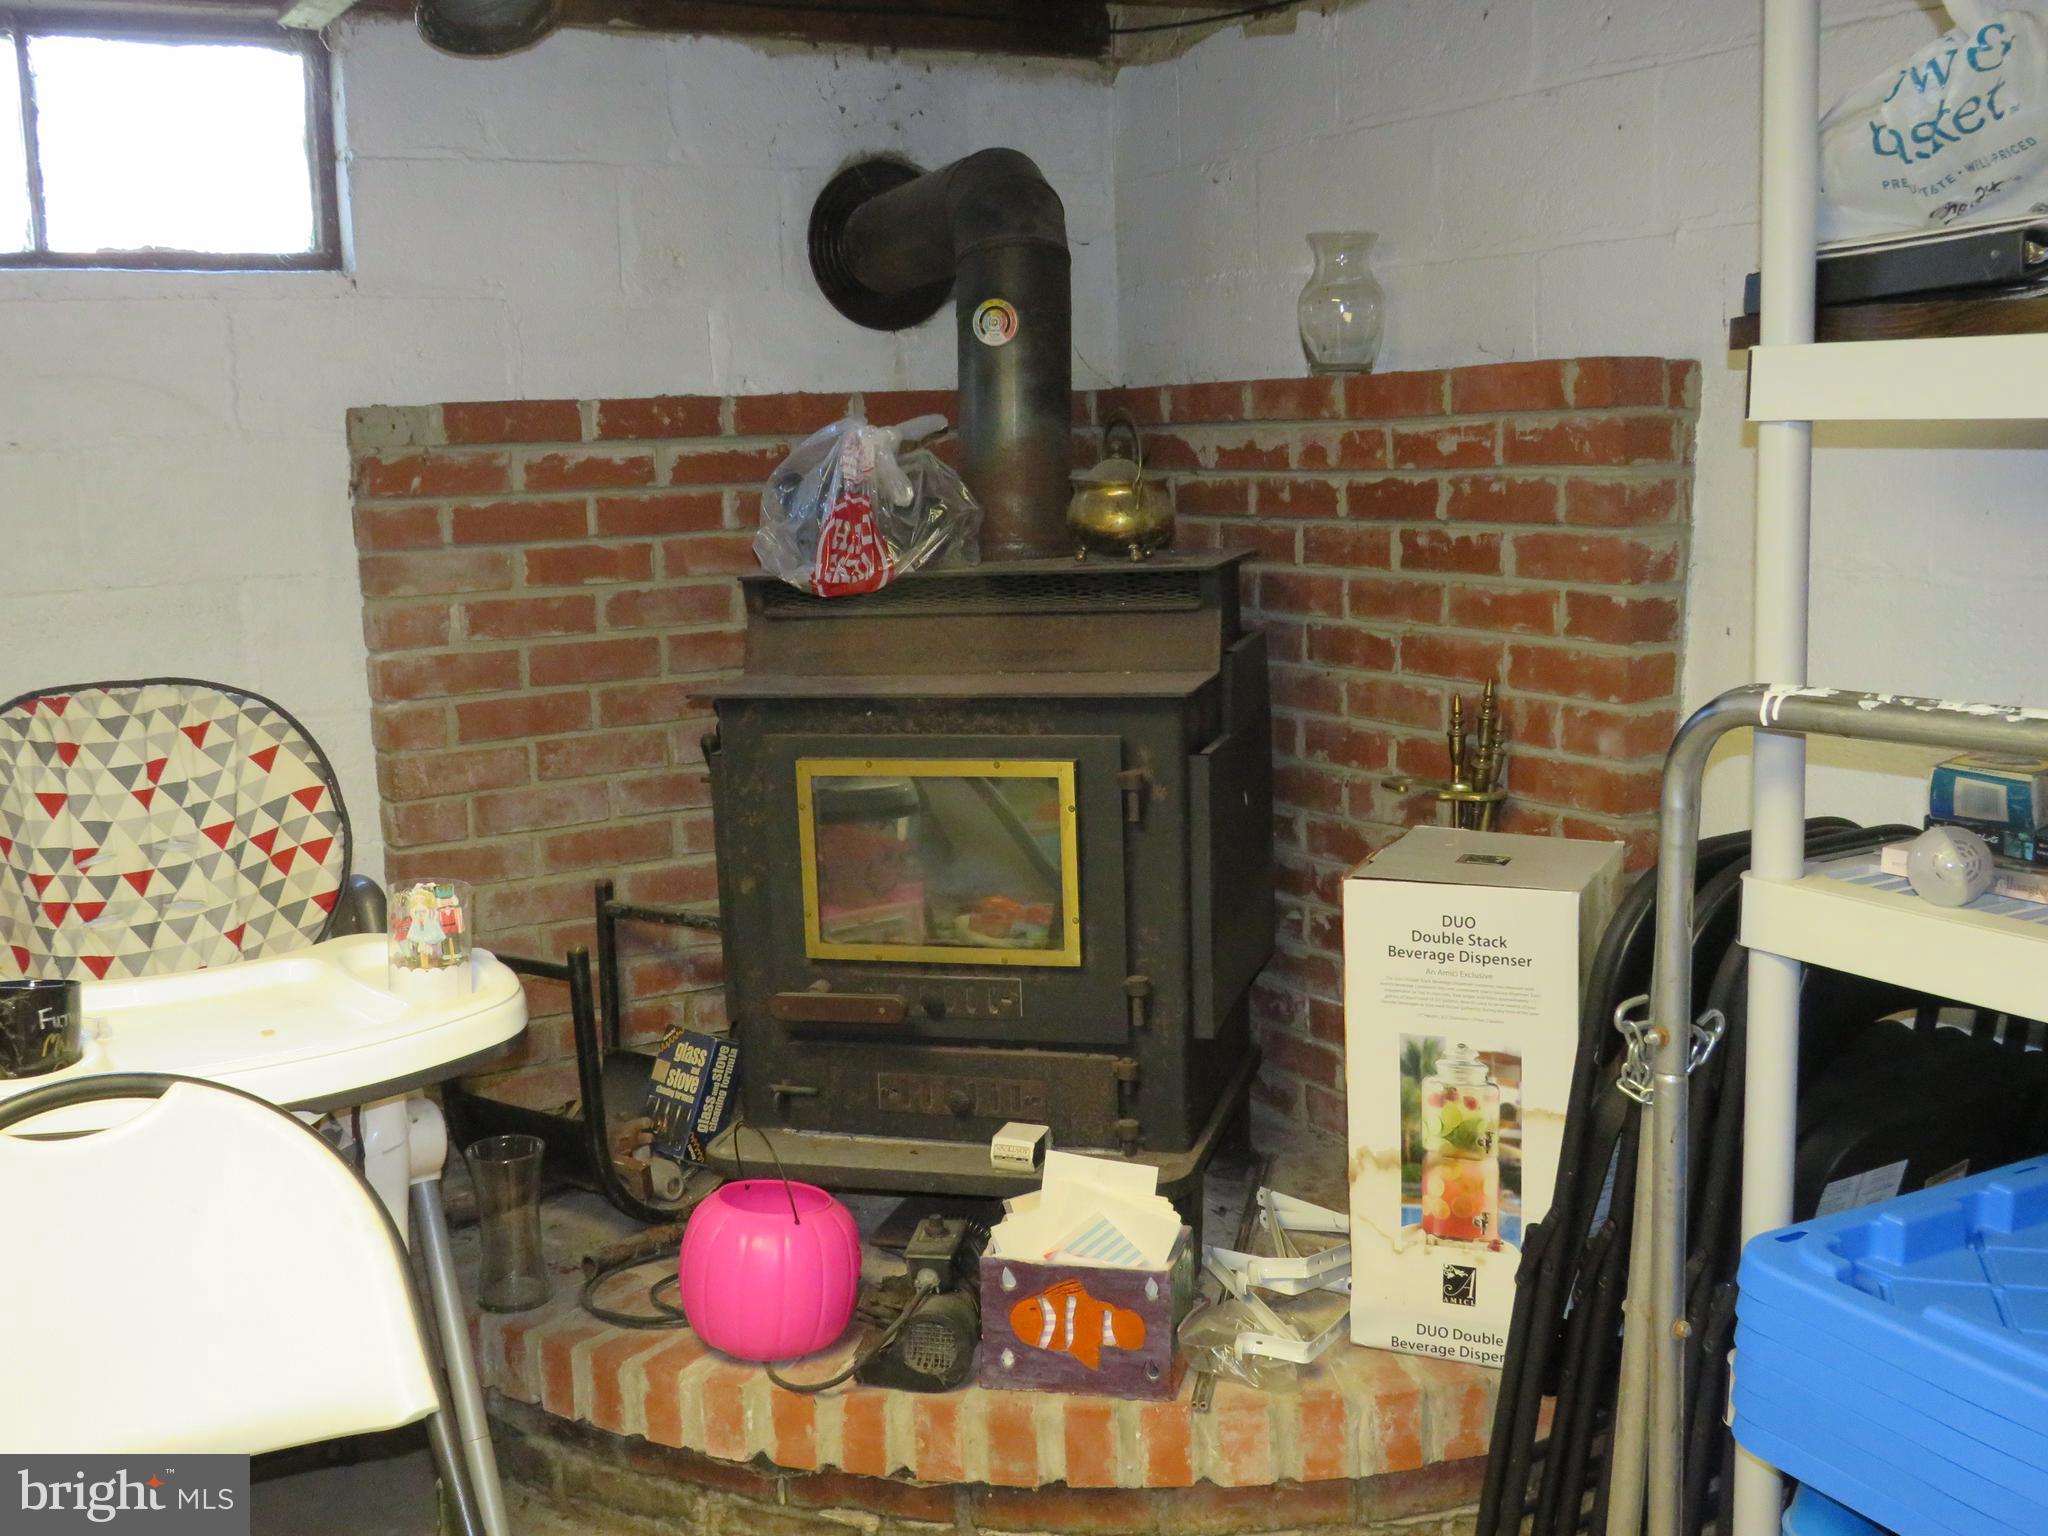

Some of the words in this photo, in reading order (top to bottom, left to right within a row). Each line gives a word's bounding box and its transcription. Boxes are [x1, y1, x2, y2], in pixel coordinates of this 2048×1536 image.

[1441, 915, 1476, 929] DUO
[1411, 930, 1464, 946] Double
[1468, 934, 1508, 949] Stack
[1387, 945, 1455, 964] Beverage
[1459, 950, 1532, 968] Dispenser
[1425, 967, 1436, 975] An
[674, 1041, 708, 1068] glass
[712, 1045, 730, 1082] stove
[666, 1068, 700, 1095] stove
[708, 1089, 727, 1132] cleaning
[721, 1048, 738, 1089] formula
[711, 1081, 721, 1097] and
[697, 1095, 717, 1134] glass
[1391, 1335, 1456, 1357] Beverage
[1416, 1323, 1448, 1339] DUO
[1453, 1328, 1504, 1347] Double
